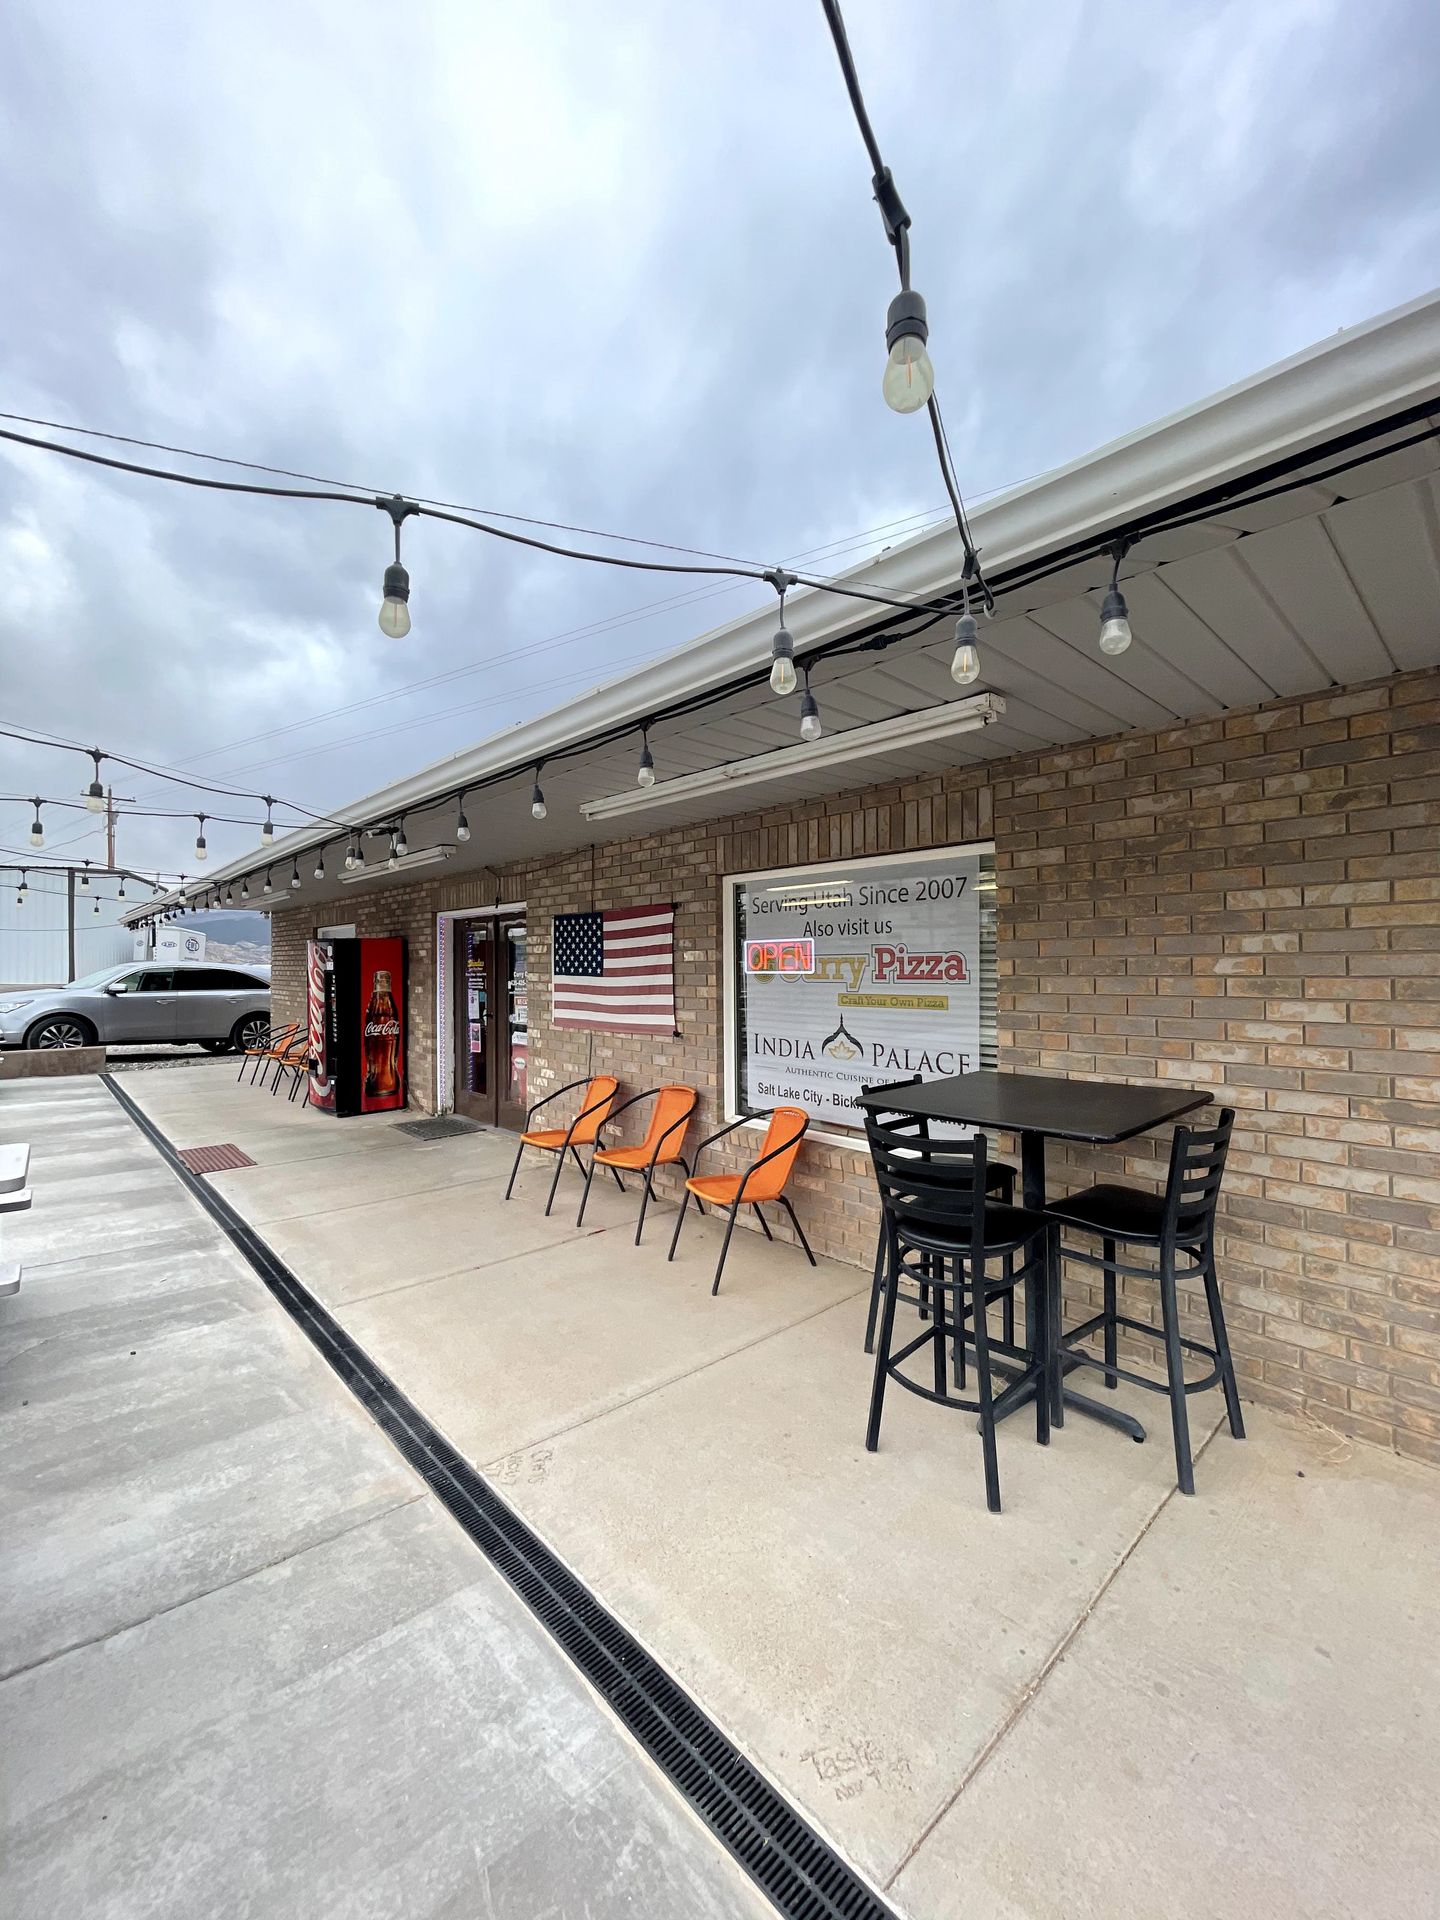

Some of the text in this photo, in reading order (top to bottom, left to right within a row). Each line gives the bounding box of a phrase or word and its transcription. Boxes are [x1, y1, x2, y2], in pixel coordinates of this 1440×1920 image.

[752, 876, 968, 916] Serving Utah Since 2007
[803, 918, 893, 937] Also visit us
[748, 942, 811, 970] OPEN
[873, 945, 967, 982] Pizza
[840, 995, 945, 1009] Craft Your Own Pizza
[364, 1020, 400, 1037] Coca-Cola
[754, 1033, 971, 1075] INDIA PALACE
[785, 1066, 834, 1079] AUTHENTIC
[836, 1072, 875, 1085] CUISINE
[757, 1081, 776, 1095] Salt
[777, 1085, 801, 1100] Lake
[803, 1089, 824, 1106] City
